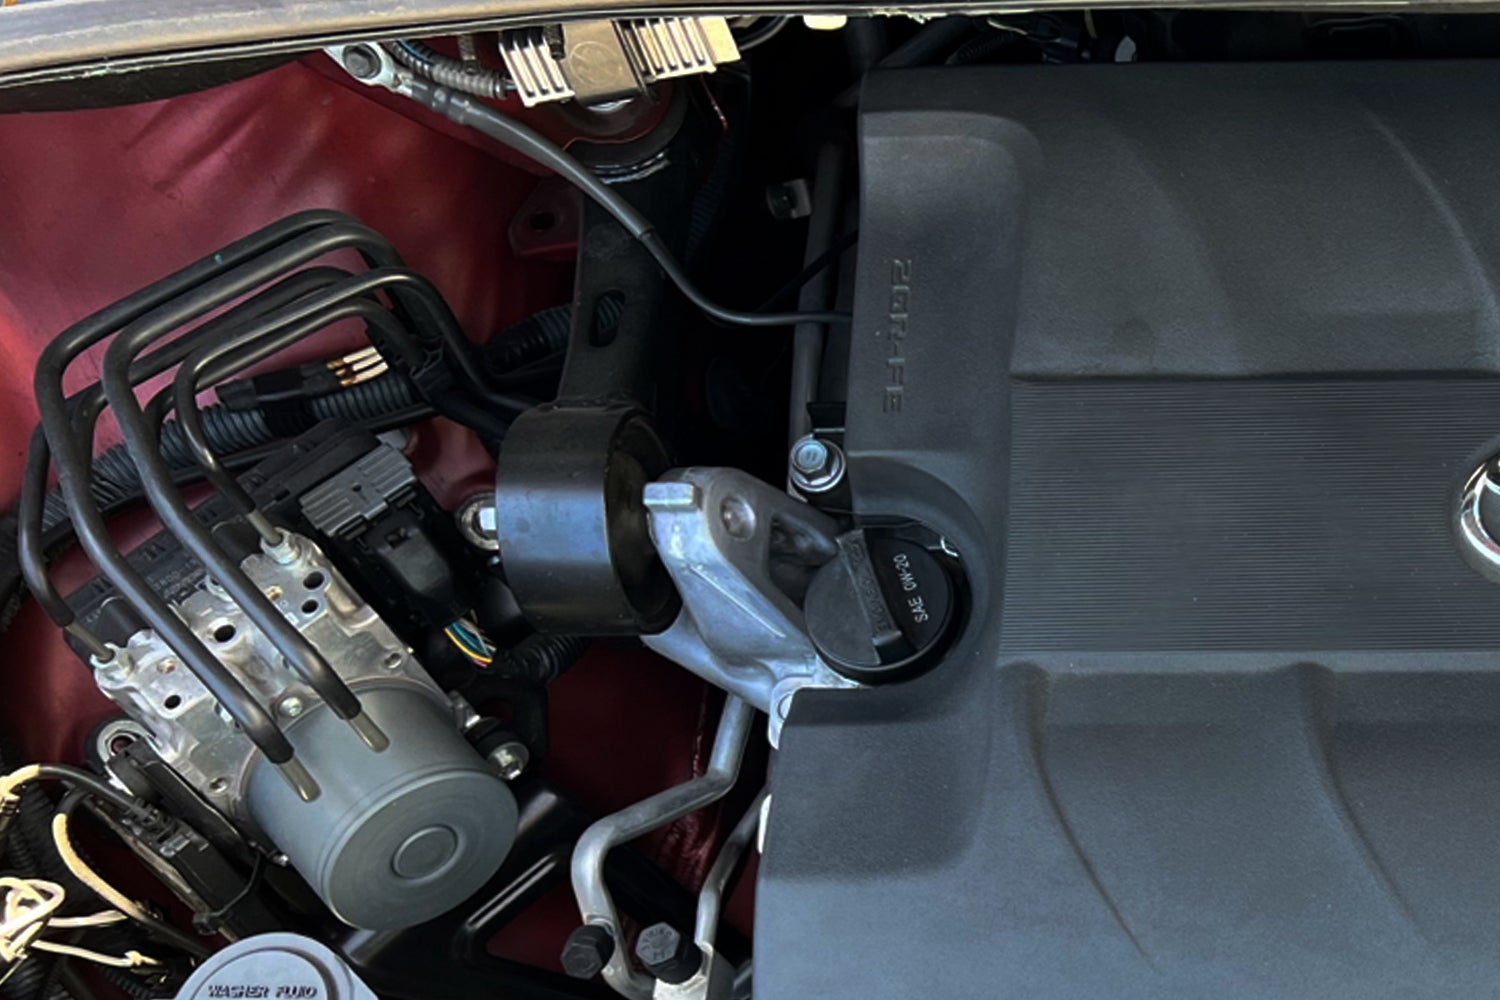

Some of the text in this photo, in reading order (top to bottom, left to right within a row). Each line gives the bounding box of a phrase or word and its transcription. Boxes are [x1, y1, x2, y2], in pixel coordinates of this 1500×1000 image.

[893, 553, 929, 623] SAE 0W-20
[208, 985, 318, 999] WASHER FLUID
